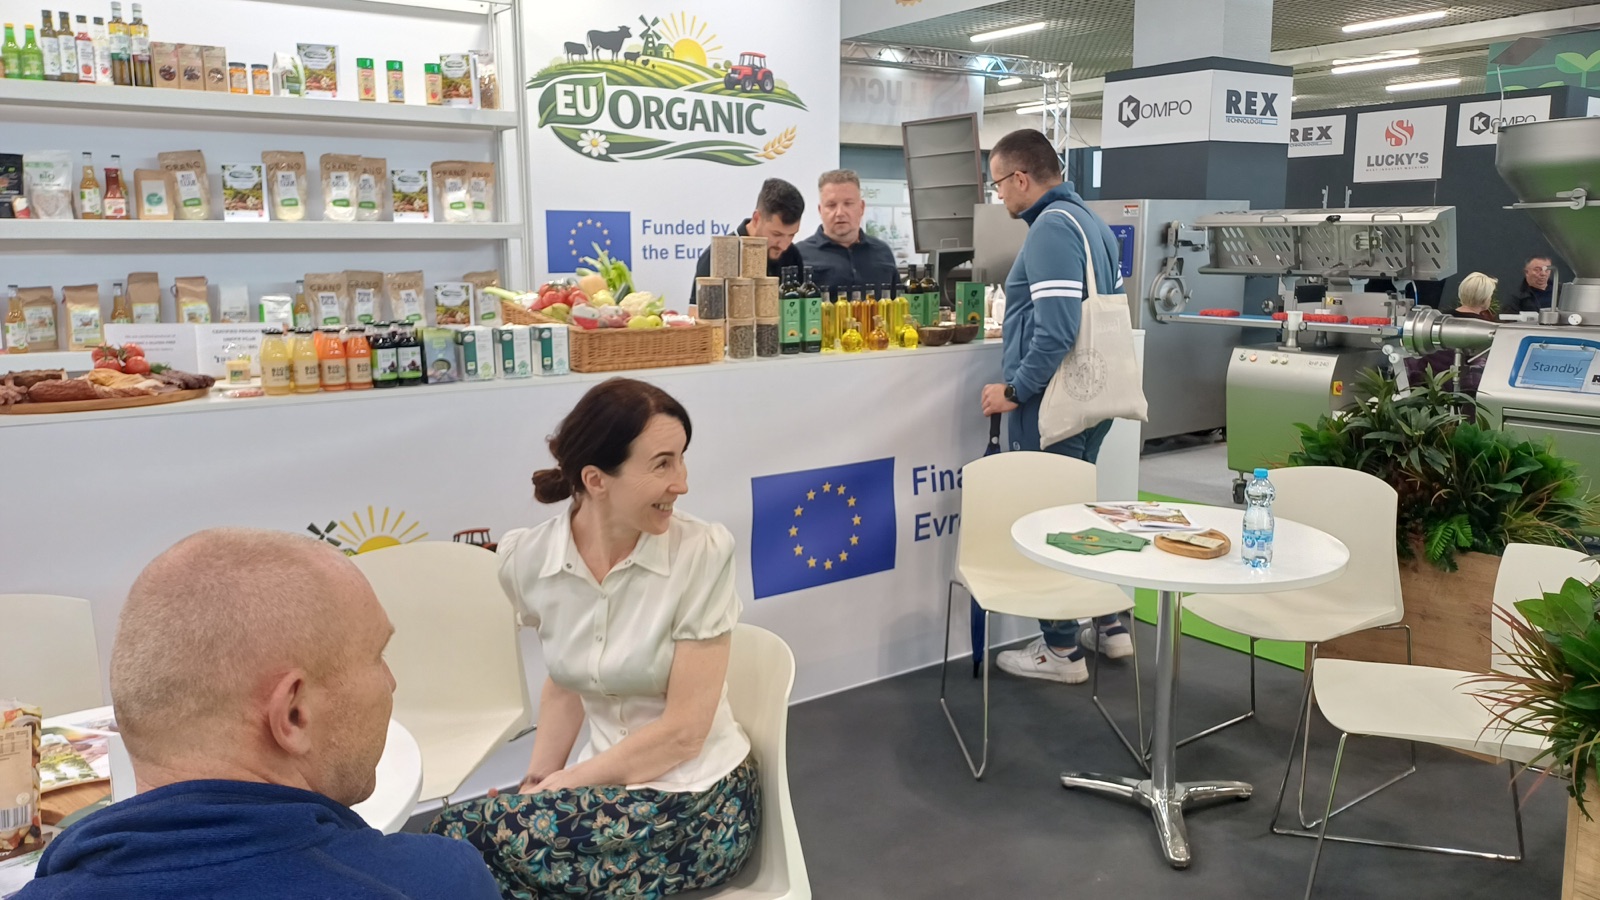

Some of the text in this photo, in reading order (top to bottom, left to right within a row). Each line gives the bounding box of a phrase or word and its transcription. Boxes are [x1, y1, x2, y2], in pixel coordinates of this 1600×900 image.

[555, 82, 767, 136] EU ORGANIC
[1120, 98, 1192, 123] KOMPO
[1225, 89, 1278, 117] REX
[1289, 125, 1333, 142] REX
[1366, 152, 1429, 167] LUCKY'S
[642, 219, 730, 236] Funded by
[642, 244, 703, 260] the Eur
[1532, 361, 1583, 377] Standby
[1592, 374, 1600, 383] R
[915, 512, 960, 541] Evr
